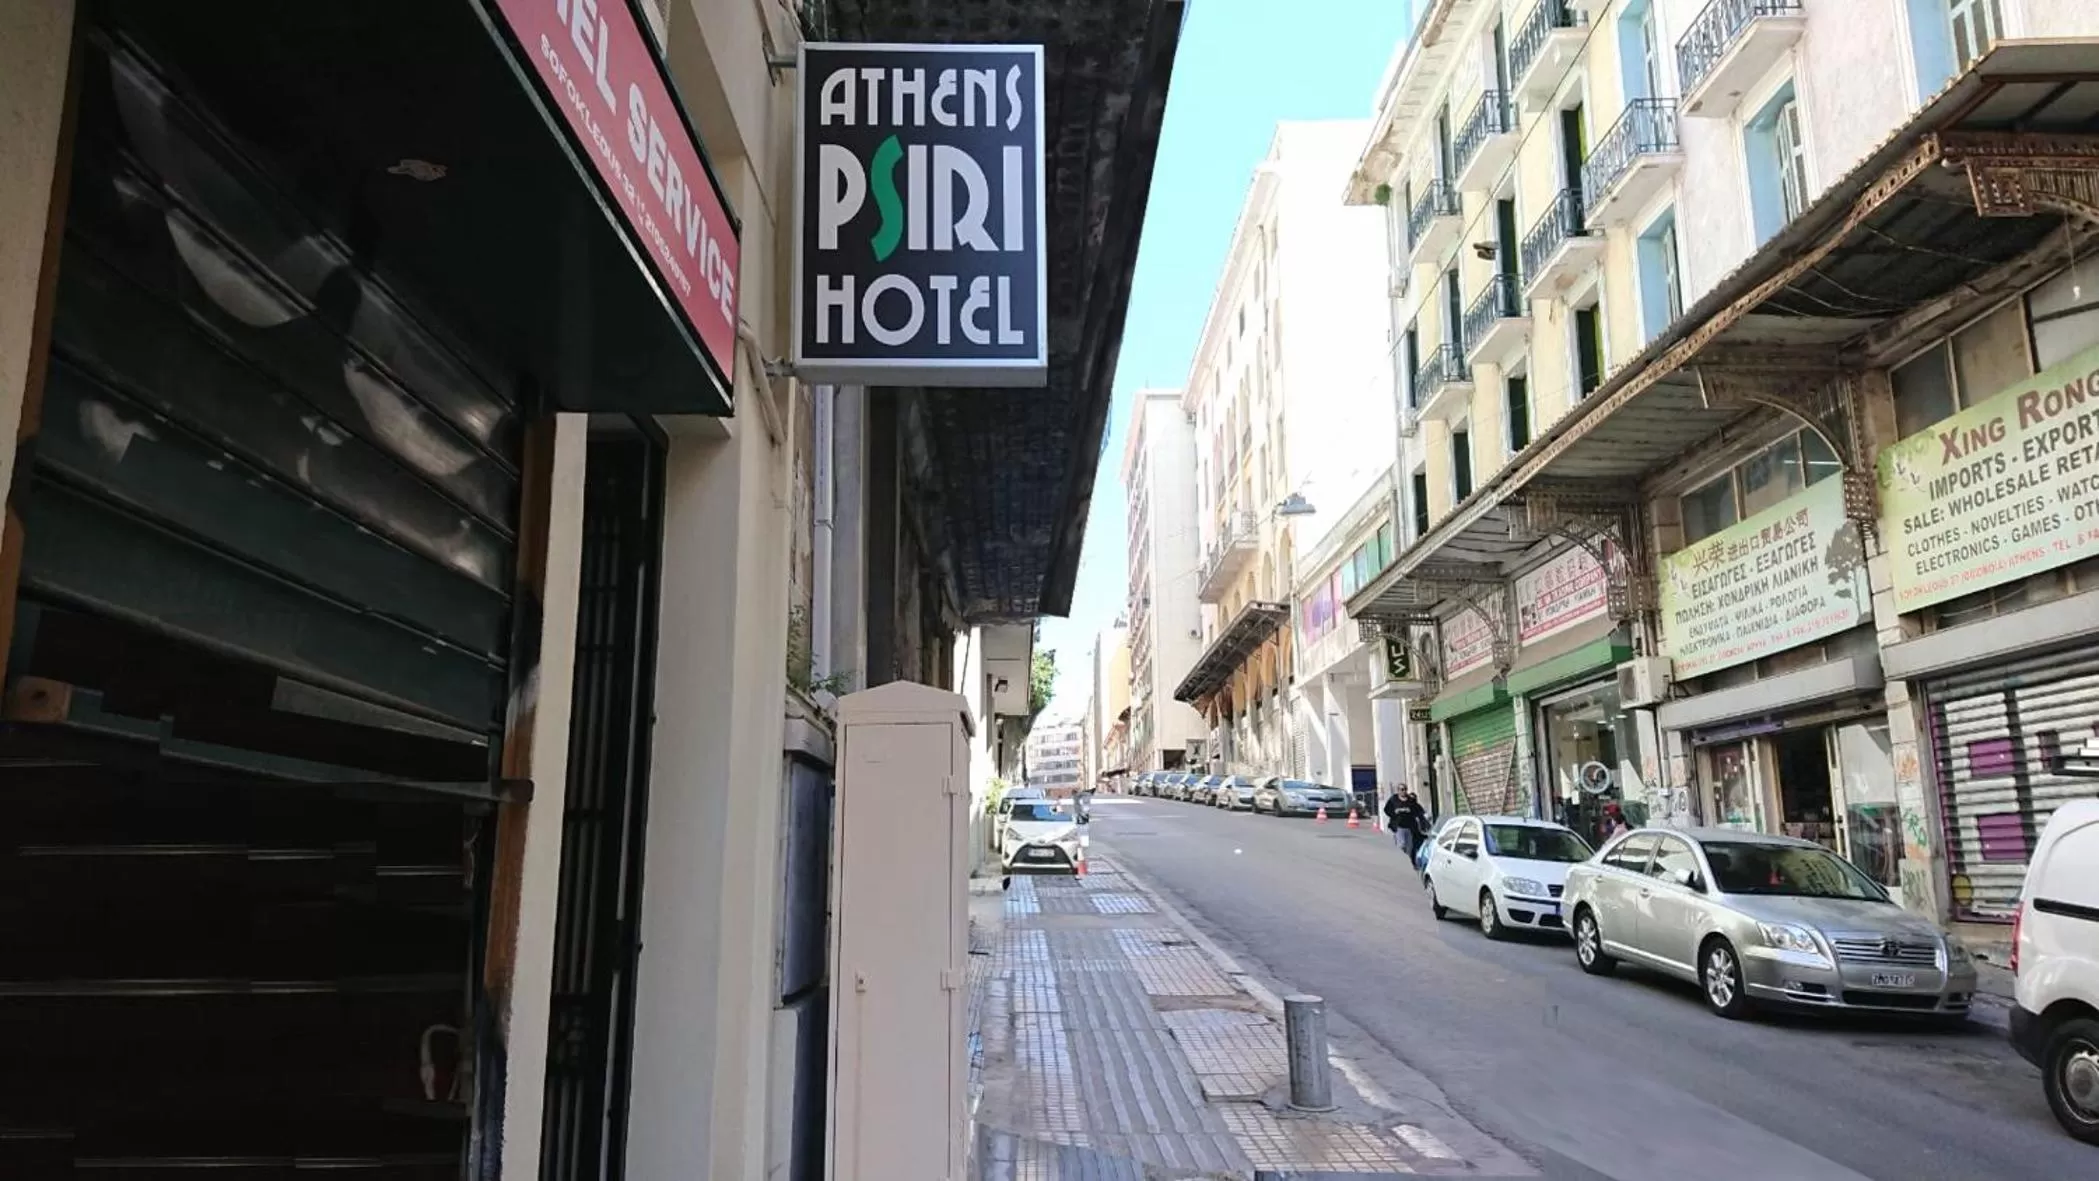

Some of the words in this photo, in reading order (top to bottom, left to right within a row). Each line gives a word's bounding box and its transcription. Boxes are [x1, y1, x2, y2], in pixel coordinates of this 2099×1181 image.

[820, 64, 1022, 132] ATHENS
[627, 82, 734, 327] SERVICE
[818, 134, 1024, 262] PSIRI
[816, 273, 1024, 346] HOTEL
[1904, 507, 1945, 535] SALE:
[1949, 464, 2052, 518] WHOLESALE
[2056, 442, 2099, 475] RET
[1930, 452, 2006, 501] IMPORTS
[1907, 527, 1961, 557] CLOTHES
[1971, 496, 2045, 535] NOVELTIES
[1916, 535, 2000, 576] ELECTRONICS
[2011, 513, 2061, 543] GAMES
[1692, 563, 1747, 599] ΕΙΣΑΓΩΓΕΣ
[1756, 532, 1817, 573] ΕΞΑΓΩΓΕΣ
